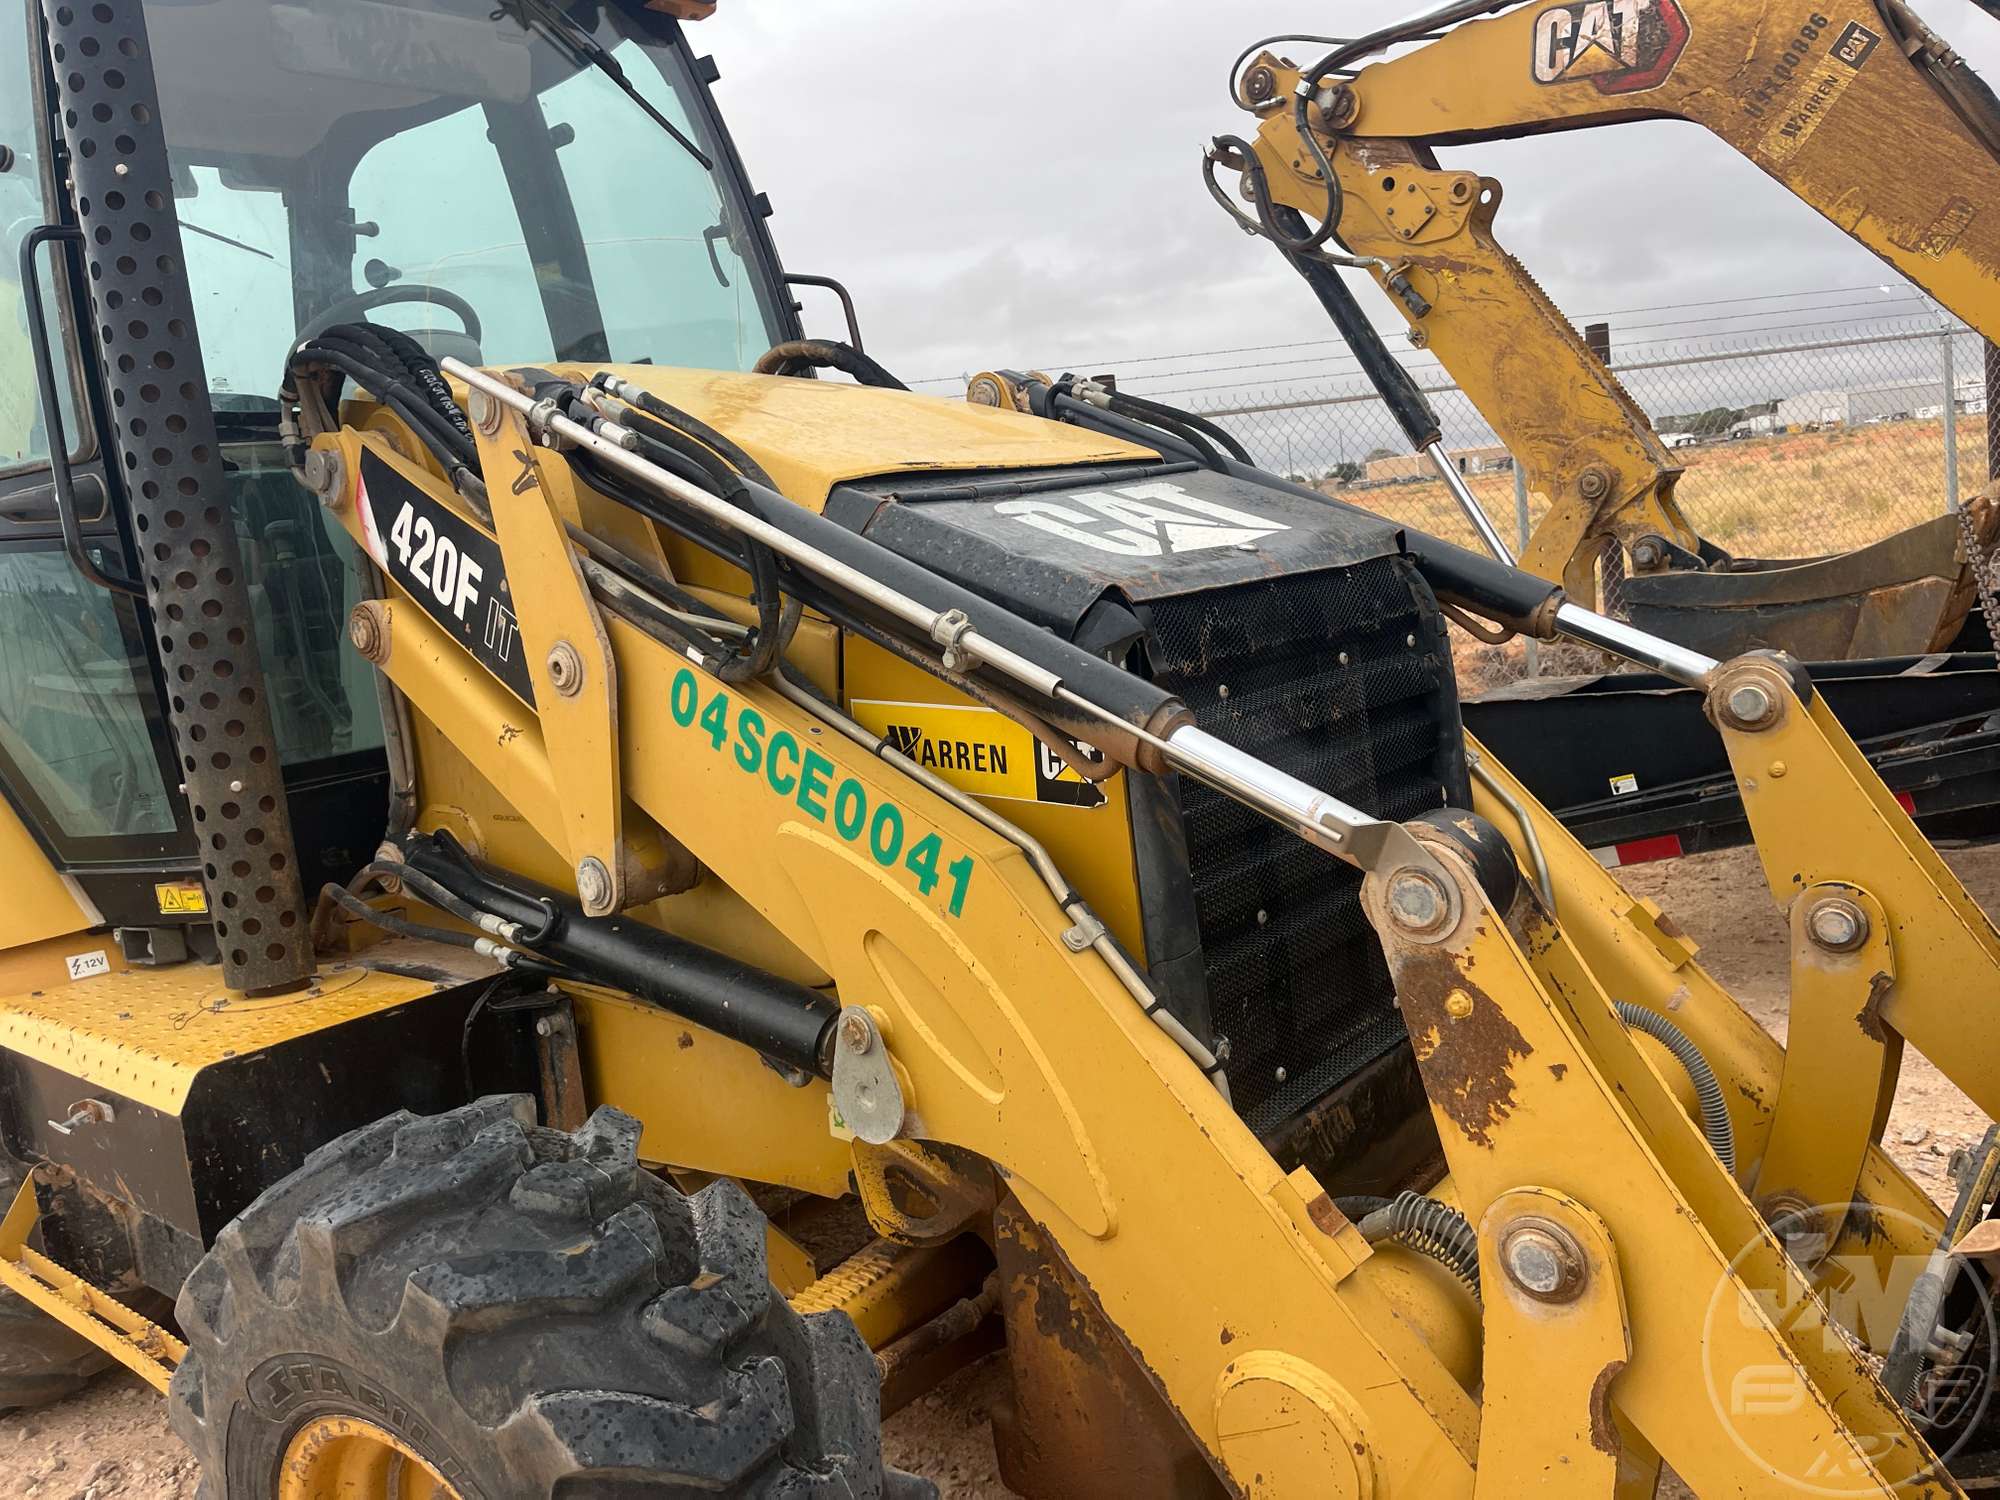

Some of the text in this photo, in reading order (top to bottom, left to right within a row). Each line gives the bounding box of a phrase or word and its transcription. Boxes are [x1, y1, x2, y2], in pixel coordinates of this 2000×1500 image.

[1535, 0, 1650, 82] CAT
[1779, 28, 1870, 139] WARREN CAT
[993, 482, 1293, 556] CAT
[391, 501, 483, 621] 420F
[484, 597, 519, 662] IT
[886, 725, 1008, 775] WARREN
[671, 668, 974, 918] 04SCE0041
[85, 957, 104, 968] 12V
